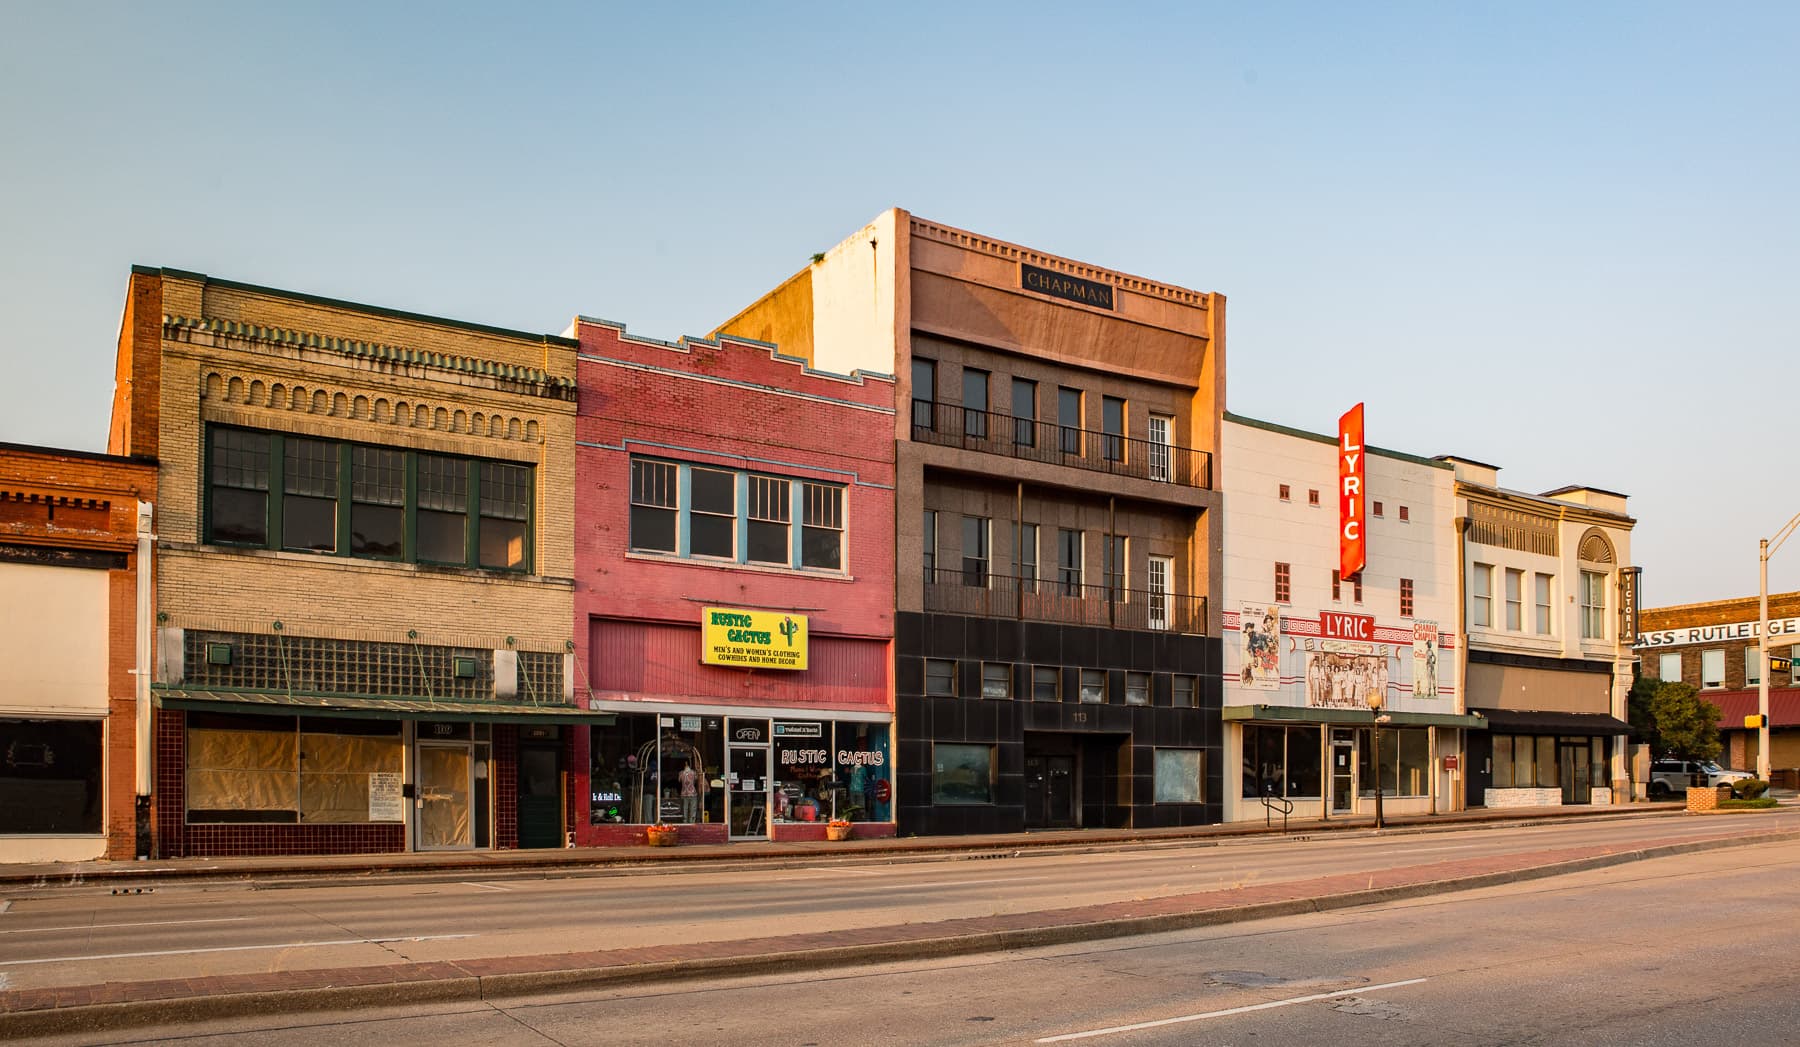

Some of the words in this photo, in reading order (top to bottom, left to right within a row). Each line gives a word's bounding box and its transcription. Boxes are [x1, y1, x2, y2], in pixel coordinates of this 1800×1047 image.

[1027, 271, 1109, 305] CHAPMAN
[1343, 432, 1360, 540] LYRIC
[711, 612, 752, 628] RUSTIC
[1326, 614, 1368, 639] LYRIC
[727, 628, 771, 645] CACTUS
[1634, 631, 1675, 647] ASS
[713, 645, 731, 654] MEN'S
[732, 647, 744, 655] AND
[746, 648, 771, 657] WOMEN'S
[773, 650, 800, 658] CLOTHING
[718, 654, 747, 662] COWHIDES
[749, 655, 760, 663] AND
[761, 656, 776, 664] HOME
[1072, 712, 1087, 722] 113
[736, 728, 761, 740] OPEN
[781, 749, 827, 765] RUSTIC
[837, 750, 884, 766] CACTUS
